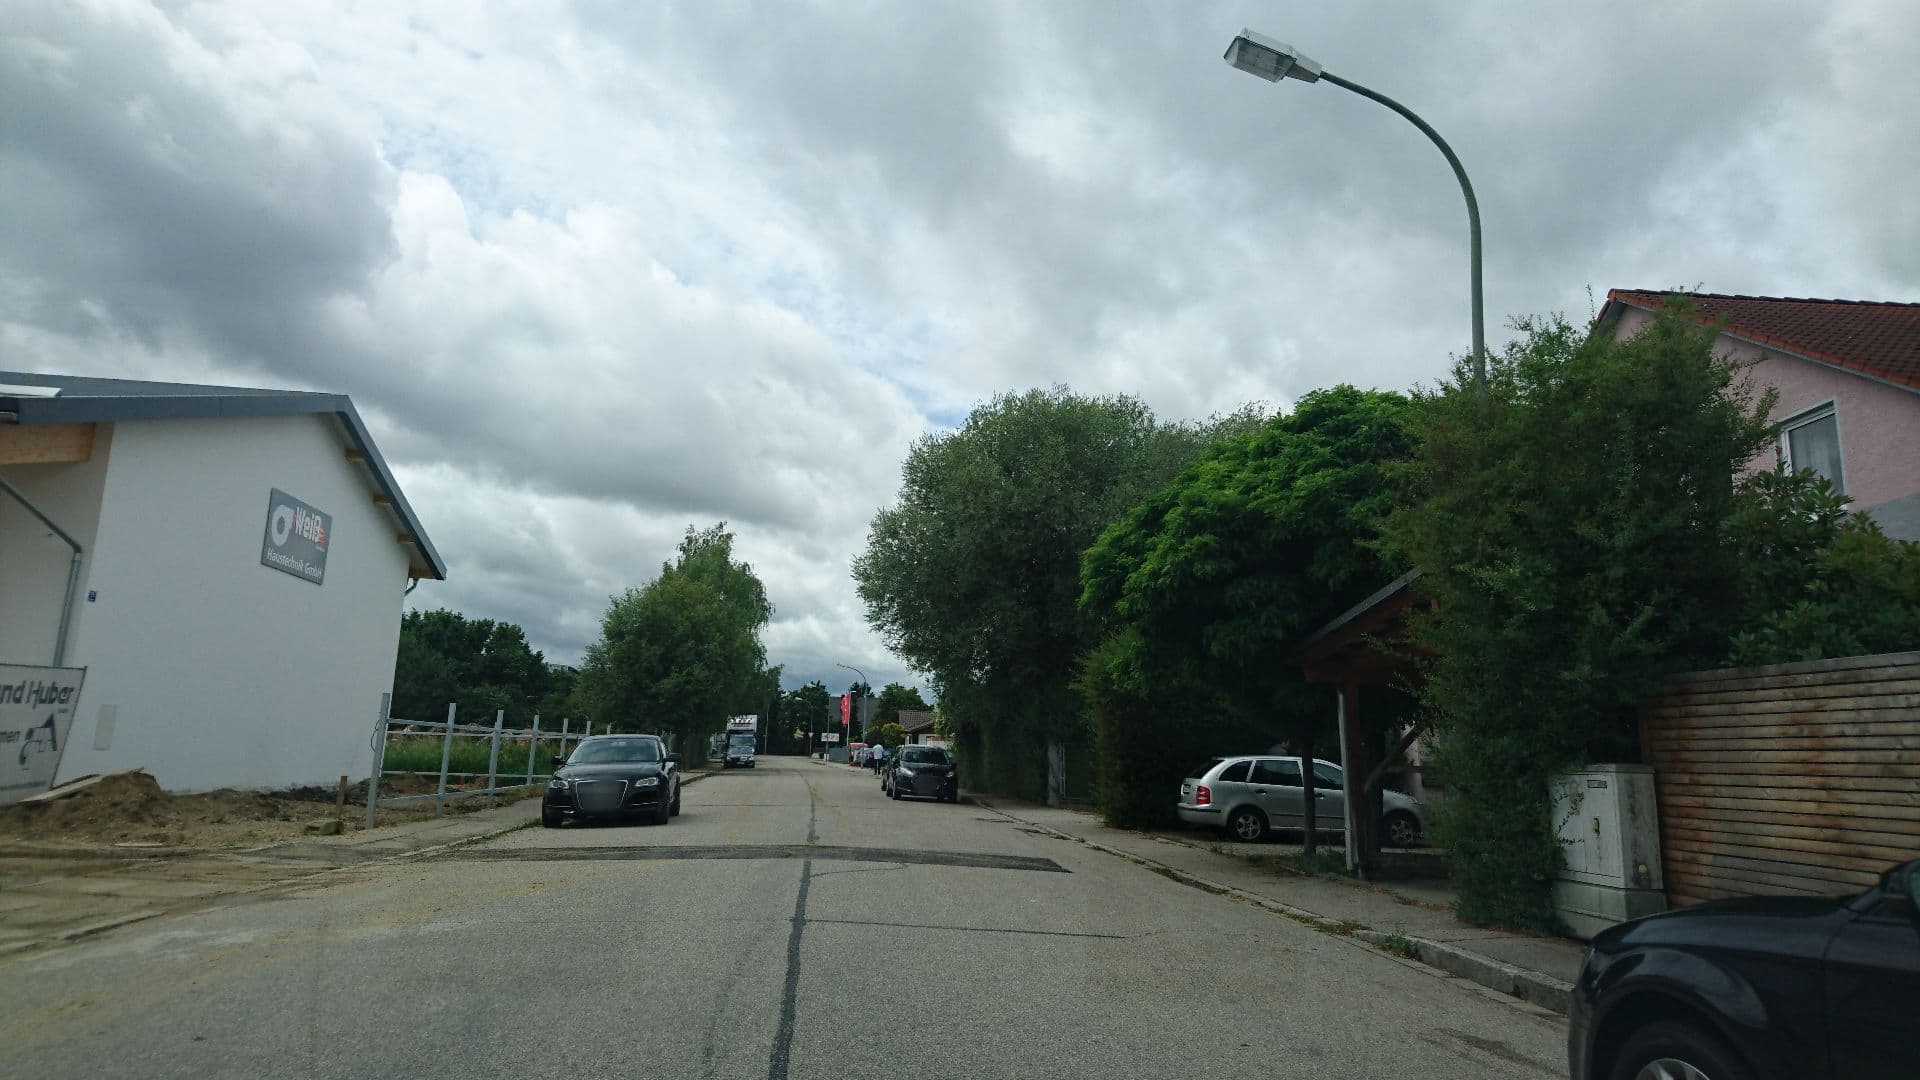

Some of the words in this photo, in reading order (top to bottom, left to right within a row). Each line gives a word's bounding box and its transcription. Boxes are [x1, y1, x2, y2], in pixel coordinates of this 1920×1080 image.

[295, 506, 322, 543] Weiß
[267, 547, 304, 572] Haustechnik
[304, 562, 322, 579] GmbH
[0, 680, 26, 704] nd
[25, 680, 74, 709] Huber
